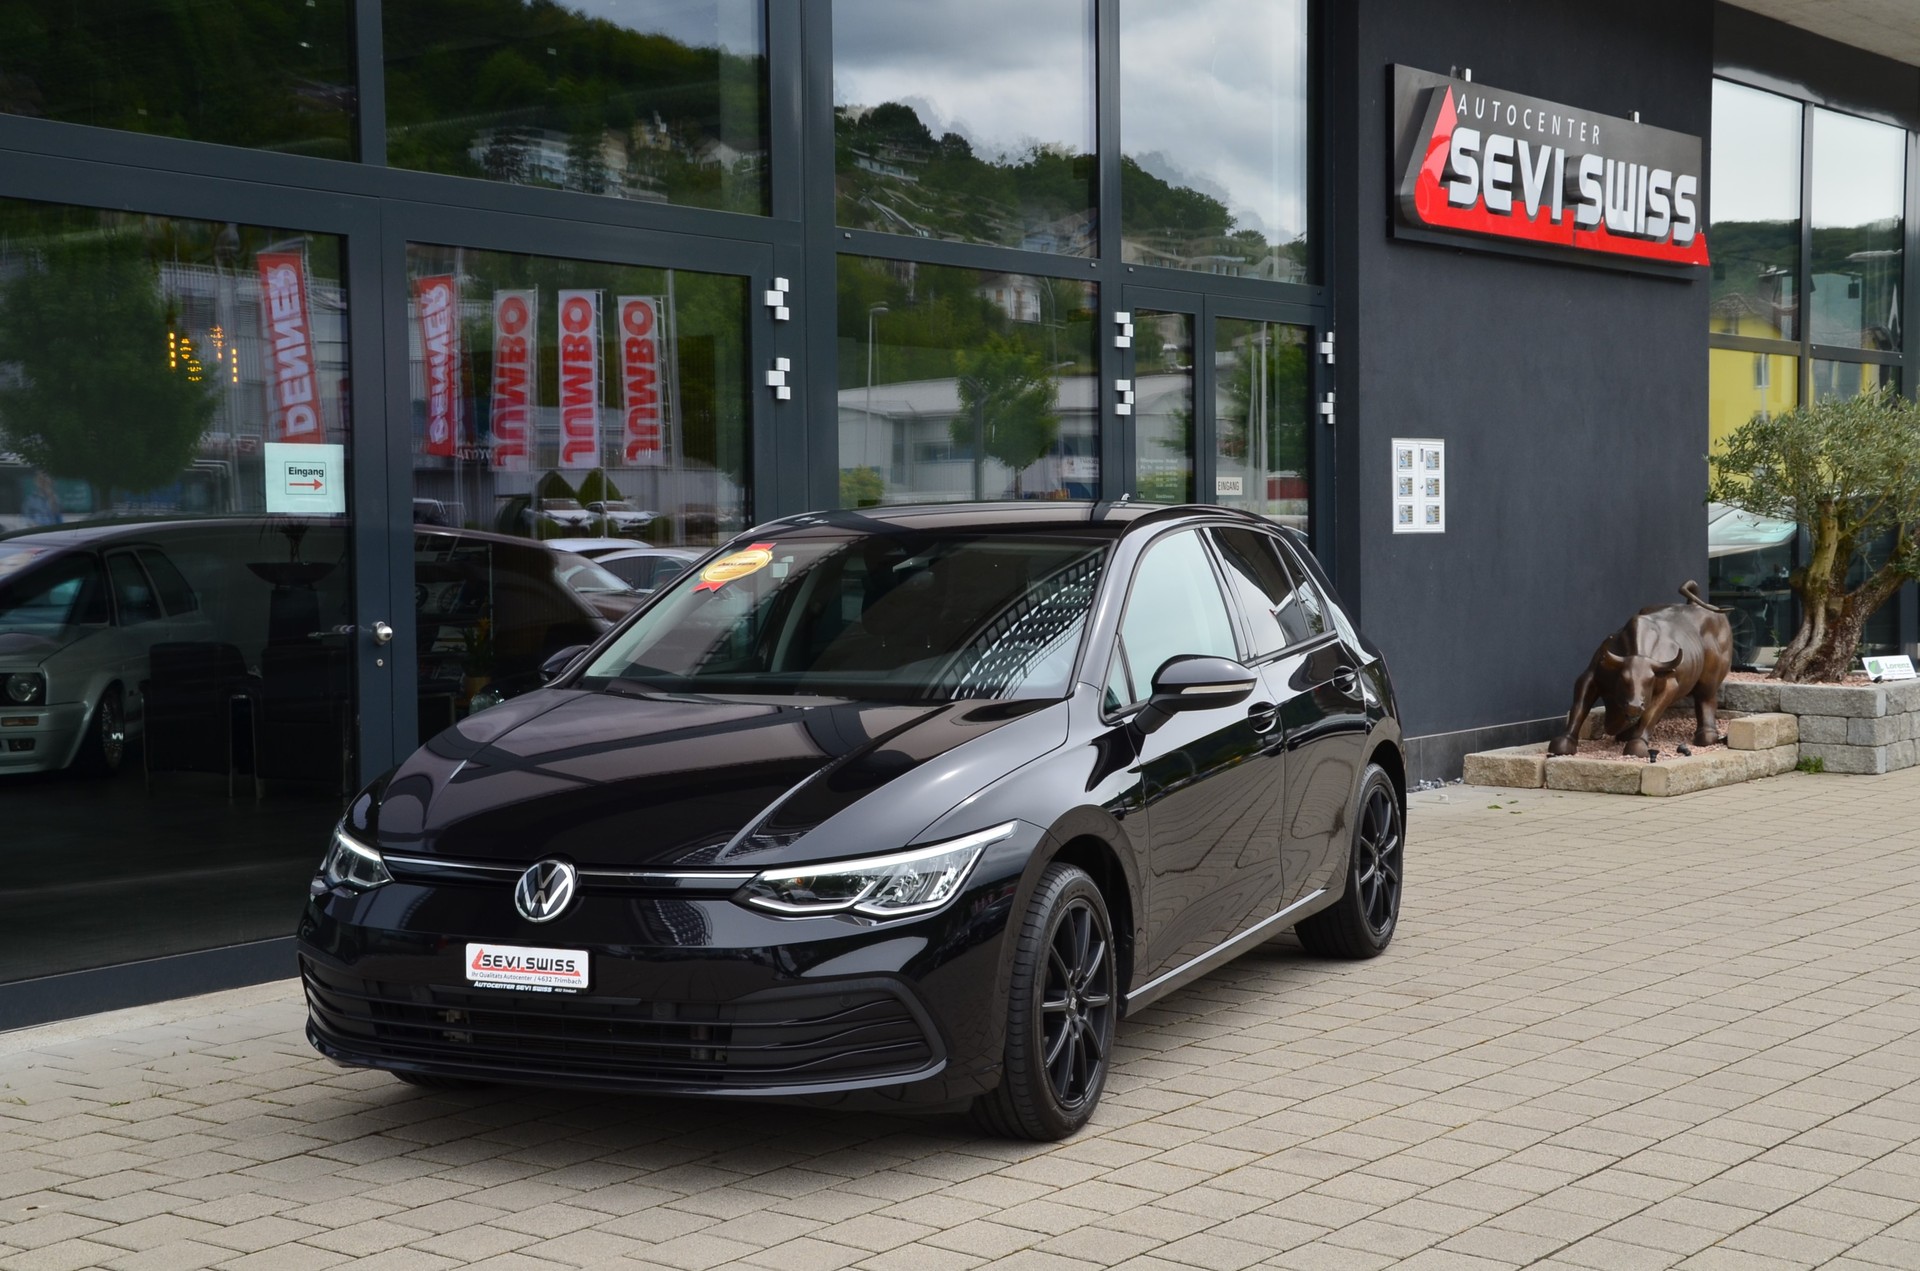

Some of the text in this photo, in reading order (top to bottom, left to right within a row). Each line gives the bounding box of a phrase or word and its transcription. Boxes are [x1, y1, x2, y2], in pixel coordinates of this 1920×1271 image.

[1457, 93, 1600, 145] AUTOCENTER
[1449, 127, 1698, 243] SEVI SWISS
[288, 466, 324, 478] Eingang
[1217, 481, 1240, 491] EINGANG
[482, 954, 575, 972] SEVI SWISS
[503, 973, 532, 981] Autocenter
